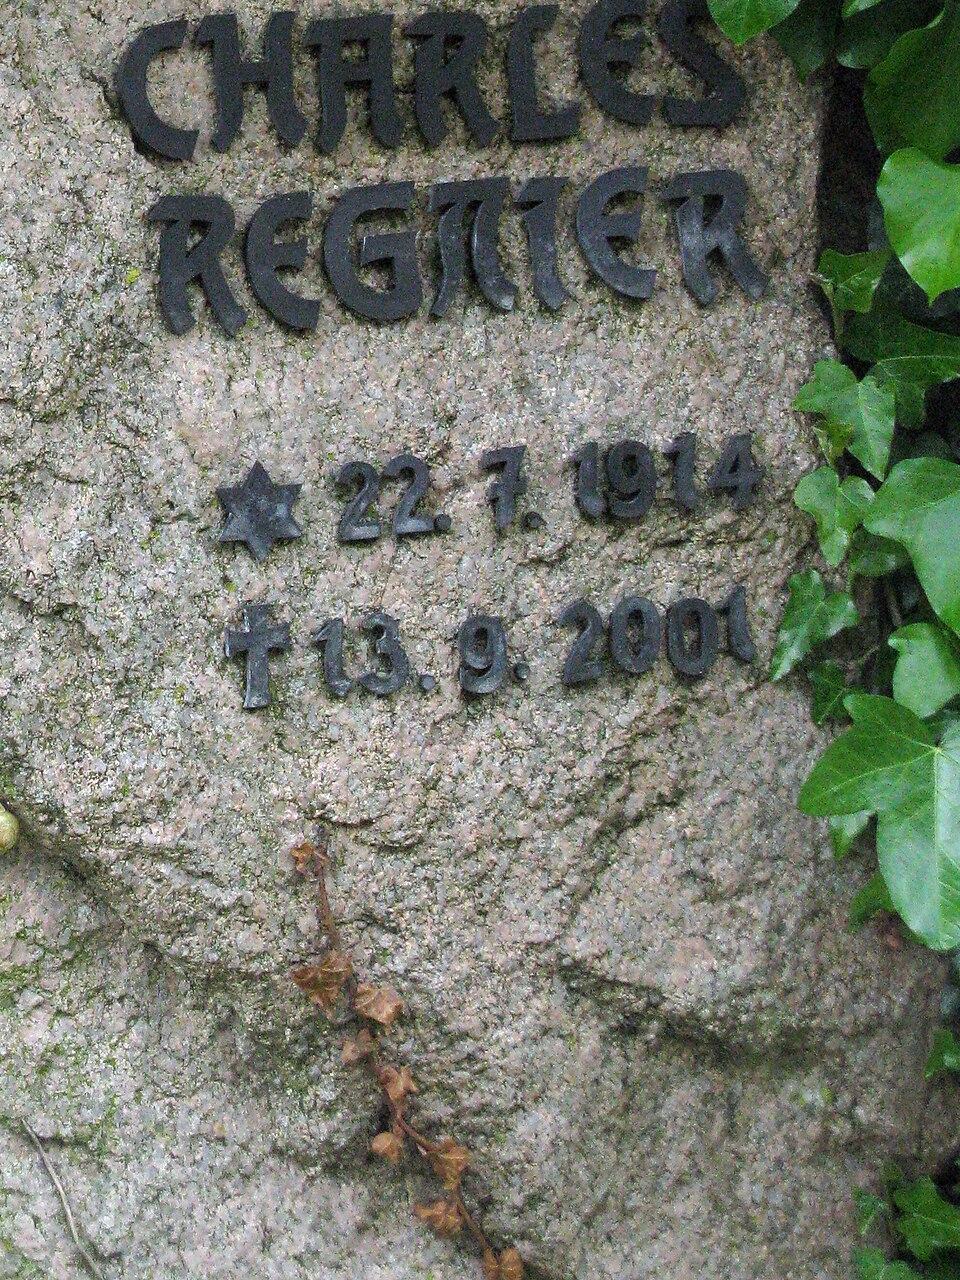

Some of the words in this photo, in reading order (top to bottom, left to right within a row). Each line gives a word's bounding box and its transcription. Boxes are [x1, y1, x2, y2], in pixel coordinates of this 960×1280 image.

[145, 166, 770, 340] REGNIER
[335, 453, 453, 544] 22.
[480, 444, 542, 535] 7.
[570, 431, 766, 520] 1914
[558, 586, 756, 688] 2001
